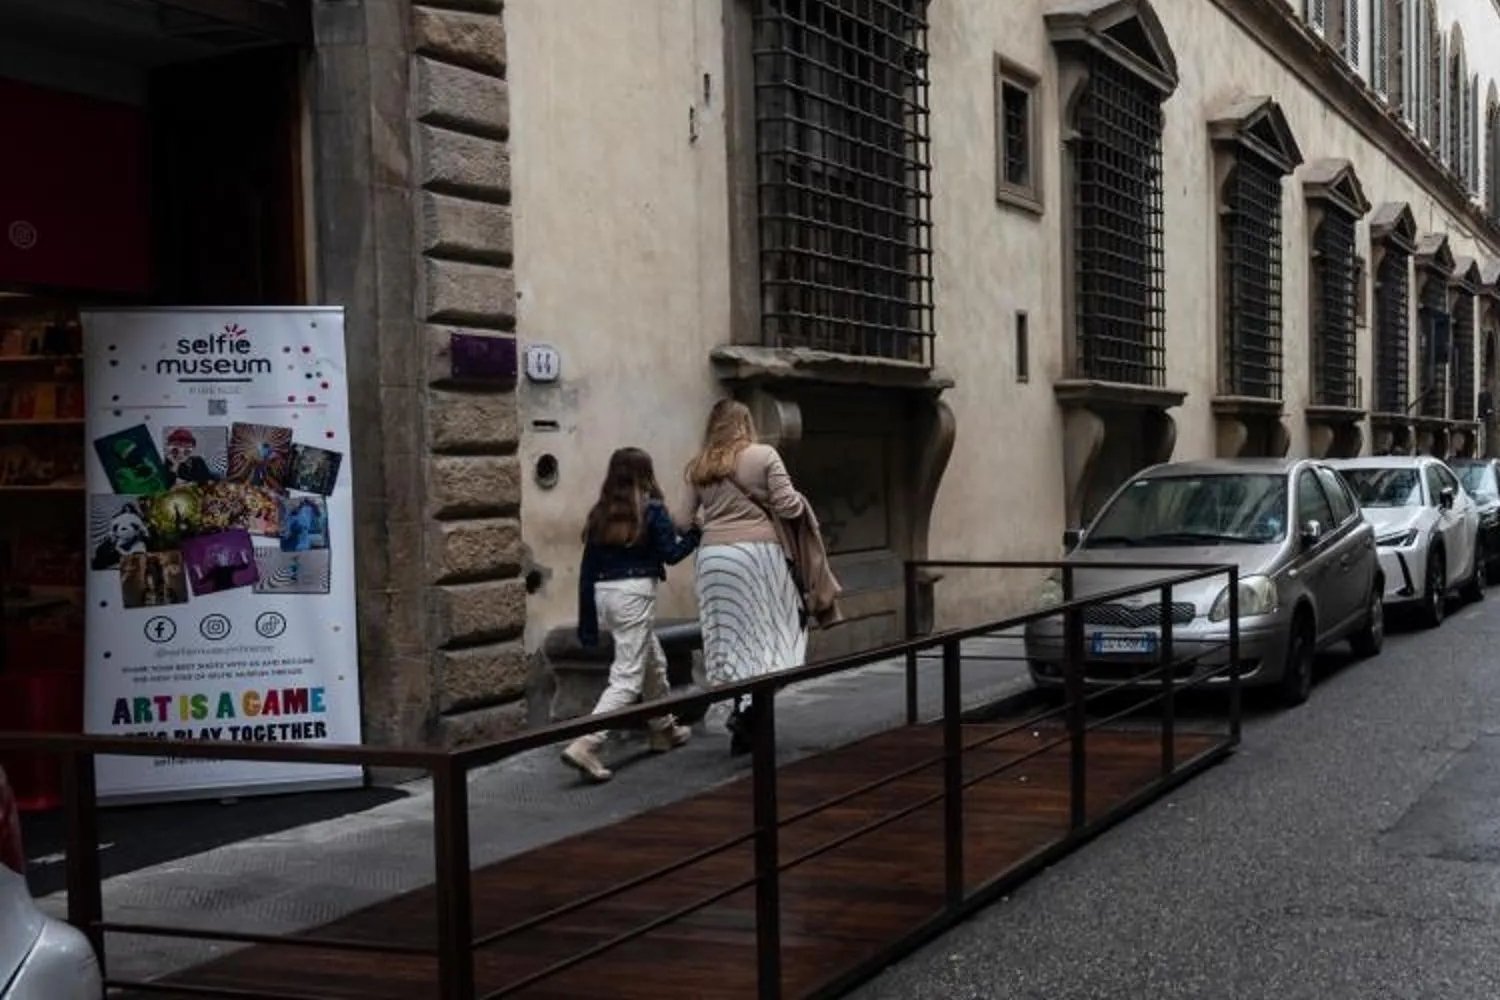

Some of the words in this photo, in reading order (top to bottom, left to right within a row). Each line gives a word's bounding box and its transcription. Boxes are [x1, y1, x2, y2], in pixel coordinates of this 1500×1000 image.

[177, 333, 251, 355] selfie
[156, 357, 272, 375] museum
[112, 695, 172, 725] ART
[180, 693, 209, 721] IS
[216, 691, 235, 719] A
[242, 687, 327, 717] GAME
[228, 721, 327, 742] TOGETHER
